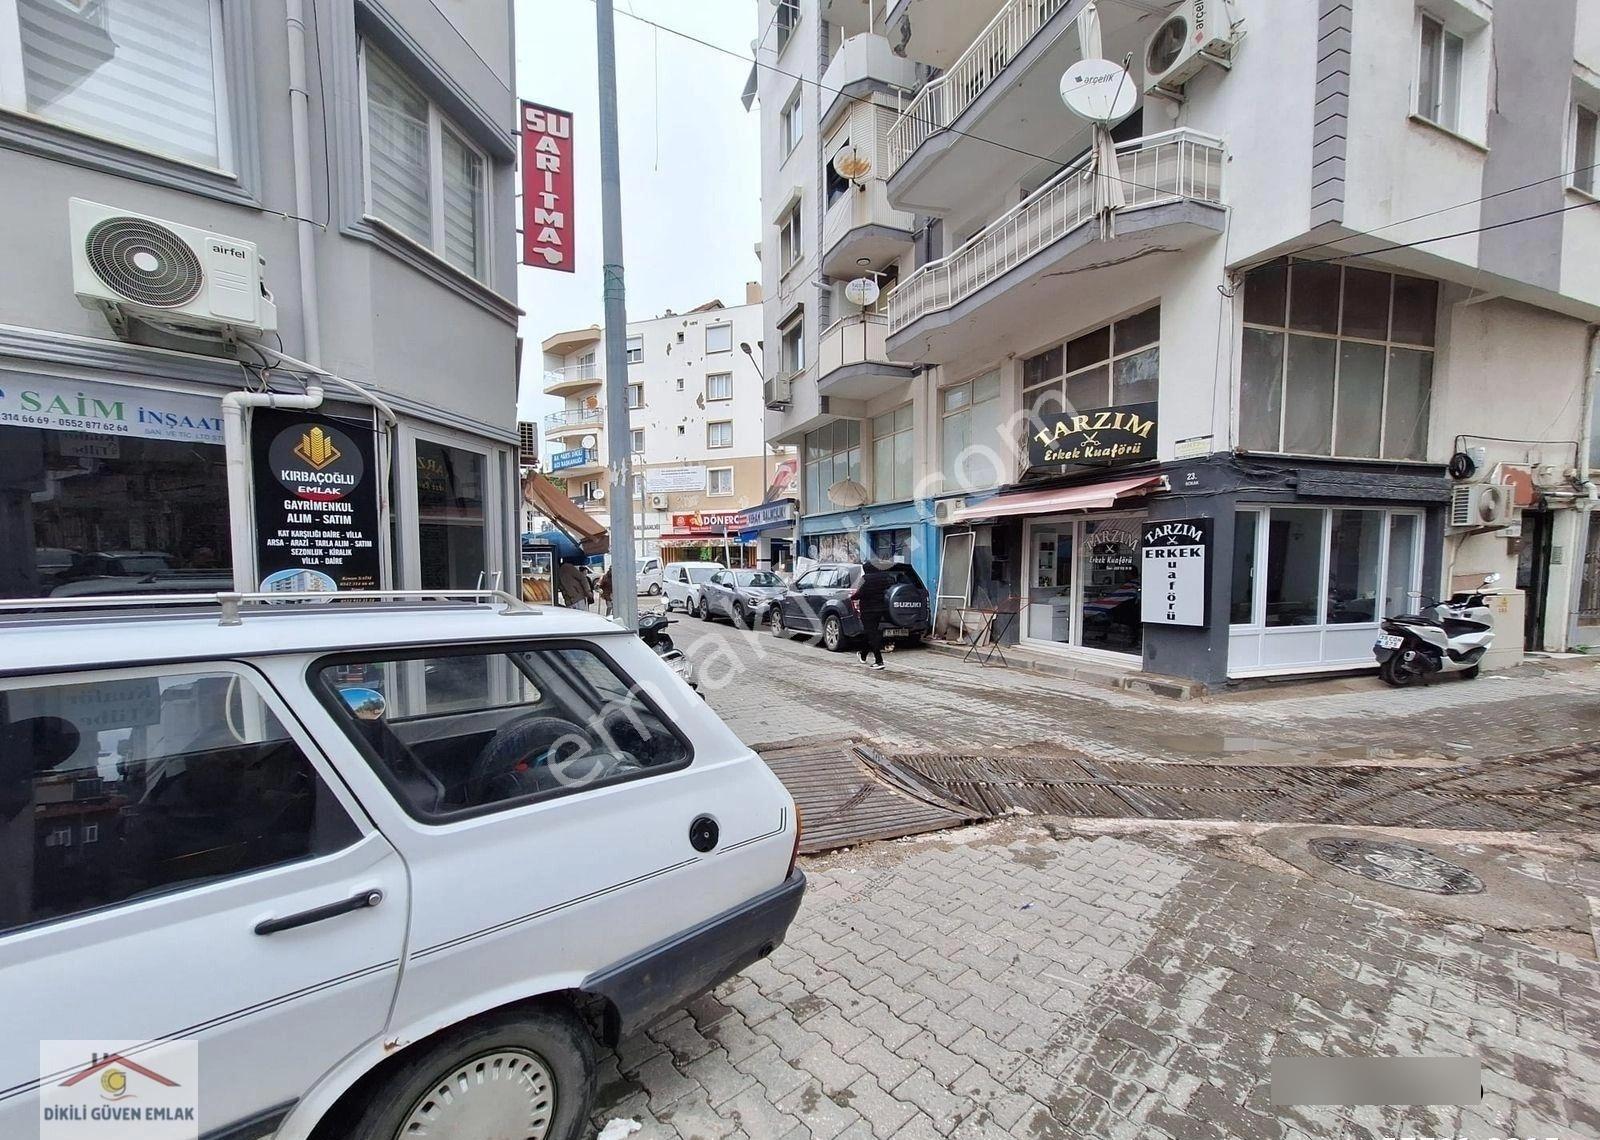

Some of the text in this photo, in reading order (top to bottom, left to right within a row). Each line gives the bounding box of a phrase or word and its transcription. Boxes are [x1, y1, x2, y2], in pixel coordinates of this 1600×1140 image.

[525, 108, 570, 139] SU
[534, 135, 564, 245] ARITMA
[212, 245, 246, 259] airfel
[20, 390, 224, 431] SAİM İNŞAAT
[22, 415, 35, 424] 66
[37, 416, 50, 425] 69
[58, 417, 83, 429] 0552
[85, 420, 101, 430] 877
[103, 422, 115, 432] 62
[117, 423, 129, 433] 64
[1034, 411, 1155, 448] TARZIM
[1044, 441, 1142, 462] Erkek Kuaförü
[281, 470, 354, 485] KIRBAÇOĞLU
[297, 485, 341, 495] EMLAK
[283, 499, 354, 513] GAYRİMENKUL
[286, 512, 312, 524] ALIM
[322, 514, 352, 525] SATIM
[277, 529, 290, 537] KAT
[1084, 528, 1139, 551] TARZIM
[1144, 523, 1203, 544] TARZIM
[266, 538, 285, 547] ARSA
[315, 539, 334, 547] TARLA
[334, 539, 350, 548] ALIM
[354, 540, 373, 548] SATIM
[1145, 547, 1201, 558] ERKEK
[301, 557, 320, 565] VİLLA
